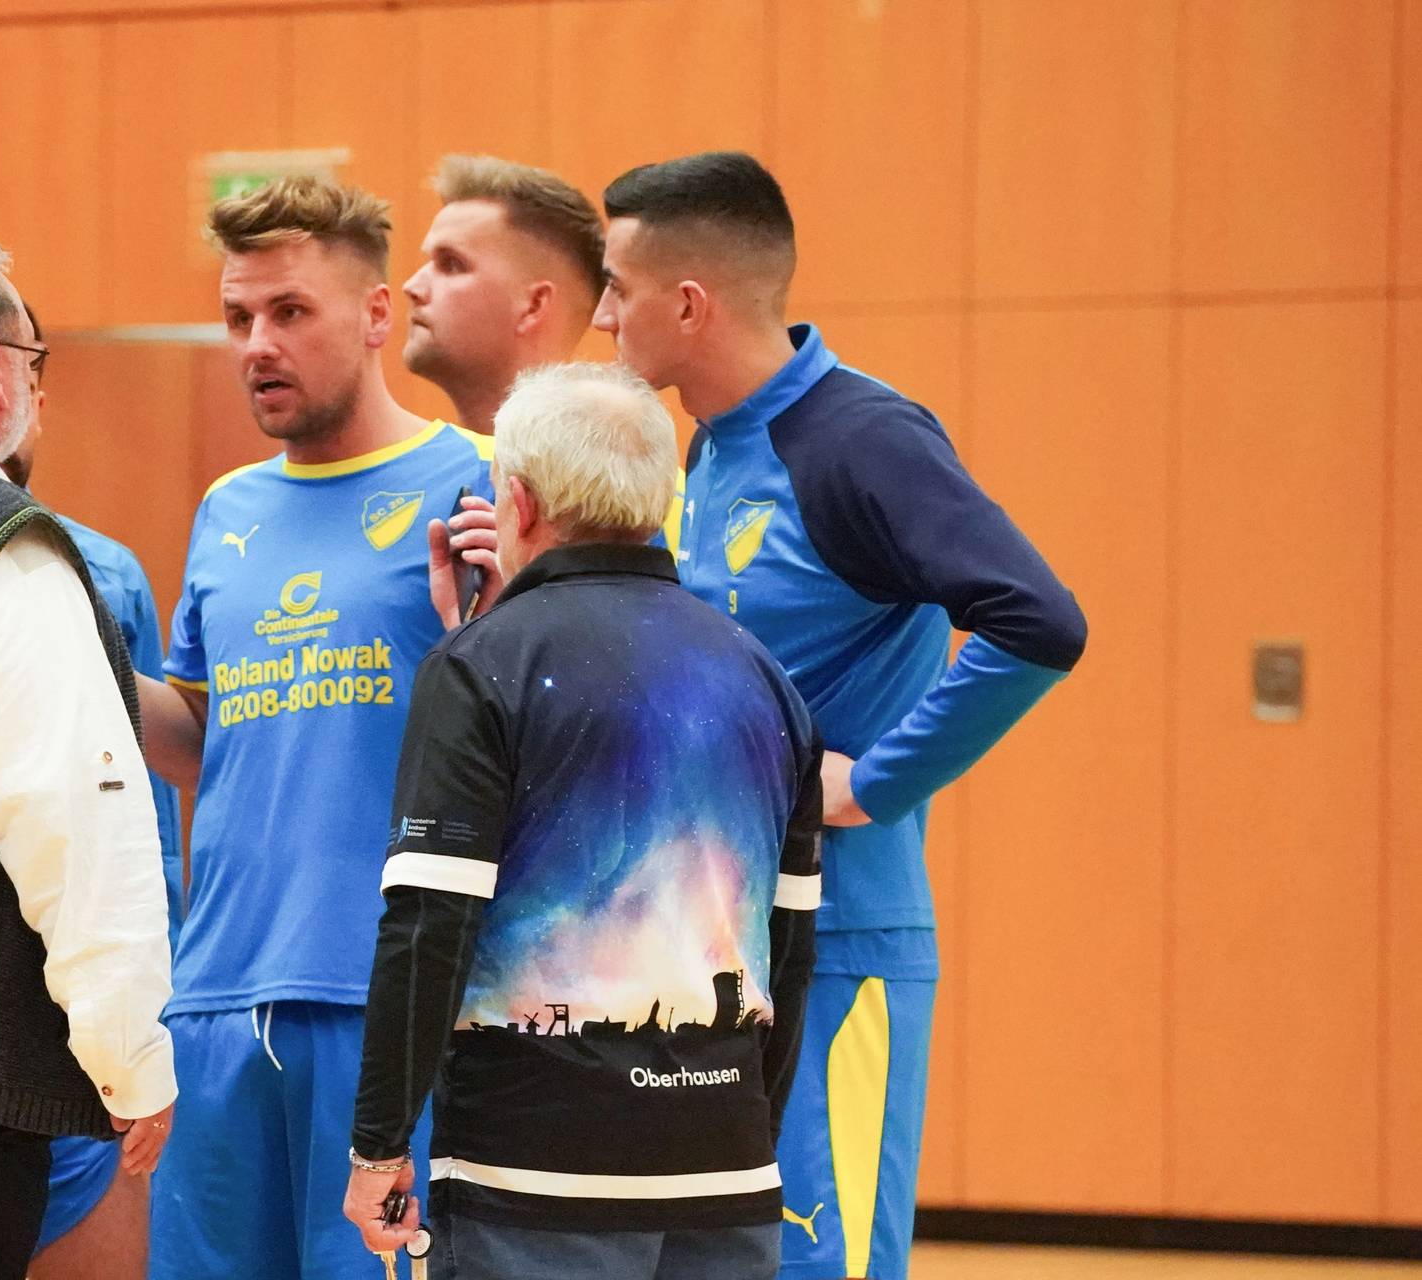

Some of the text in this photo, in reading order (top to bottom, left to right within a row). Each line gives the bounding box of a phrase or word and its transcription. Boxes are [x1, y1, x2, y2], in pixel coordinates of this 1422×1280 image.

[729, 590, 737, 614] 9
[255, 608, 339, 635] Continentale
[214, 637, 392, 694] Roland Nowak
[219, 675, 394, 727] 0208-800092
[630, 1066, 740, 1087] Oberhausen
